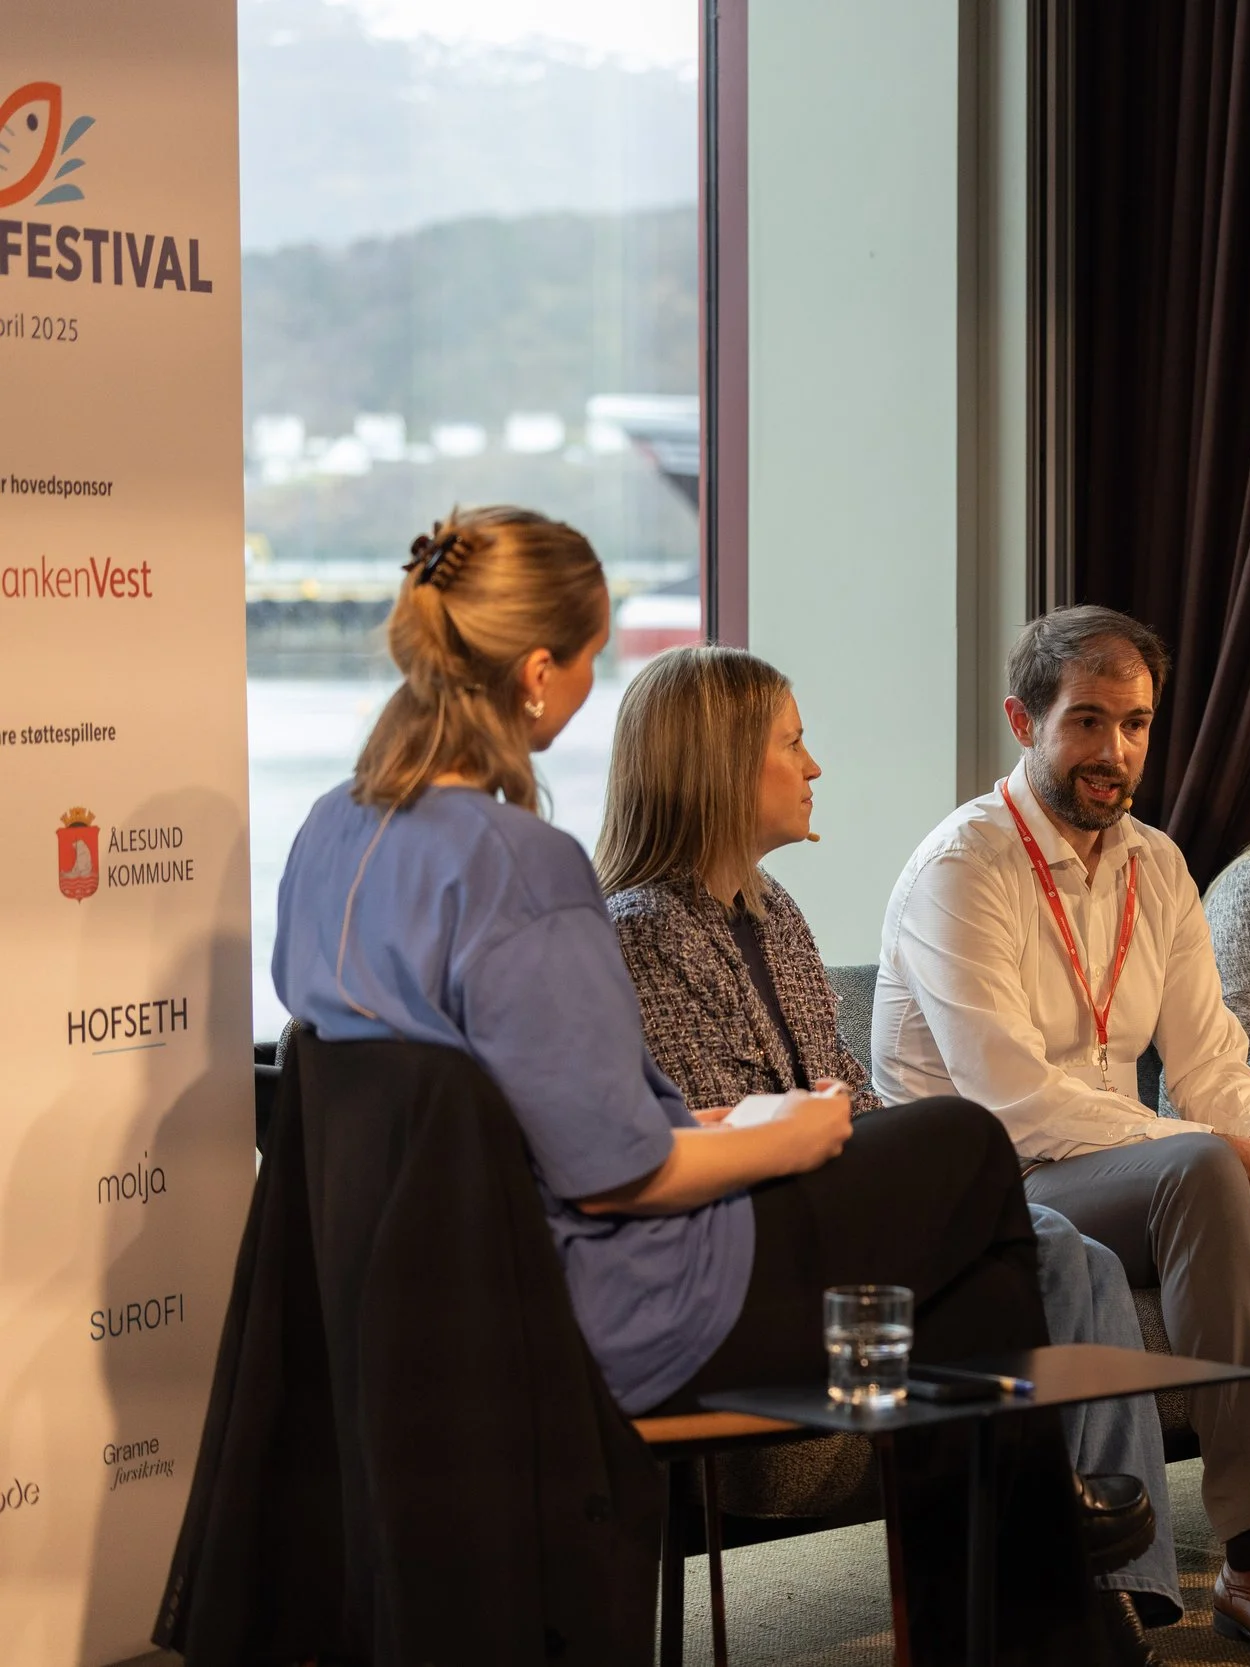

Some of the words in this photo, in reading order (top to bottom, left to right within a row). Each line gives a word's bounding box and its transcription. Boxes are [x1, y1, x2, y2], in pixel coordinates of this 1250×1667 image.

[0, 219, 213, 293] FESTIVAL
[31, 315, 78, 342] 2025
[10, 473, 113, 499] hovedsponsor
[2, 555, 153, 598] ankenVest
[0, 730, 16, 745] re
[21, 722, 116, 746] støttespillere
[108, 826, 183, 854] ÅLESUND
[107, 859, 194, 888] KOMMUNE
[67, 997, 188, 1045] HOFSETH
[98, 1151, 166, 1204] molja
[90, 1293, 184, 1341] SUROFI
[103, 1438, 159, 1465] Granne
[110, 1458, 175, 1490] forsikring
